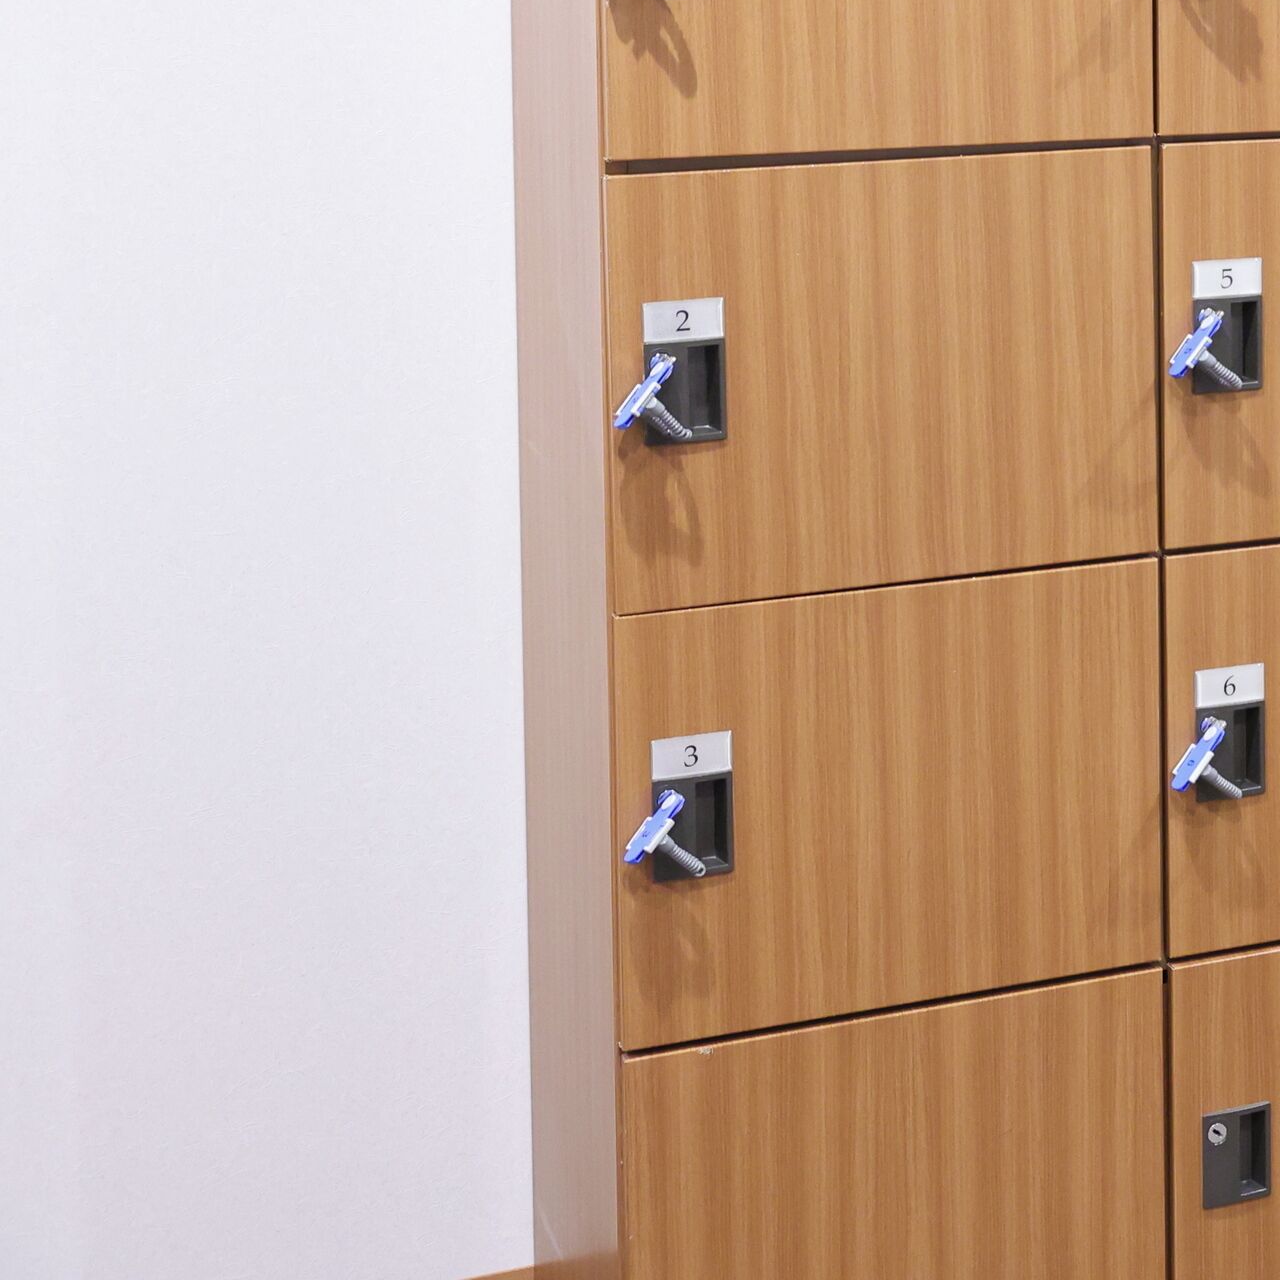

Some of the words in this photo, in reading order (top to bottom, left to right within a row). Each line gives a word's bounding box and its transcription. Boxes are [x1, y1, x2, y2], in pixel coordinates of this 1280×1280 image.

[1221, 268, 1233, 289] 5
[676, 310, 691, 332] 2
[1224, 676, 1236, 696] 6
[684, 745, 698, 767] 3
